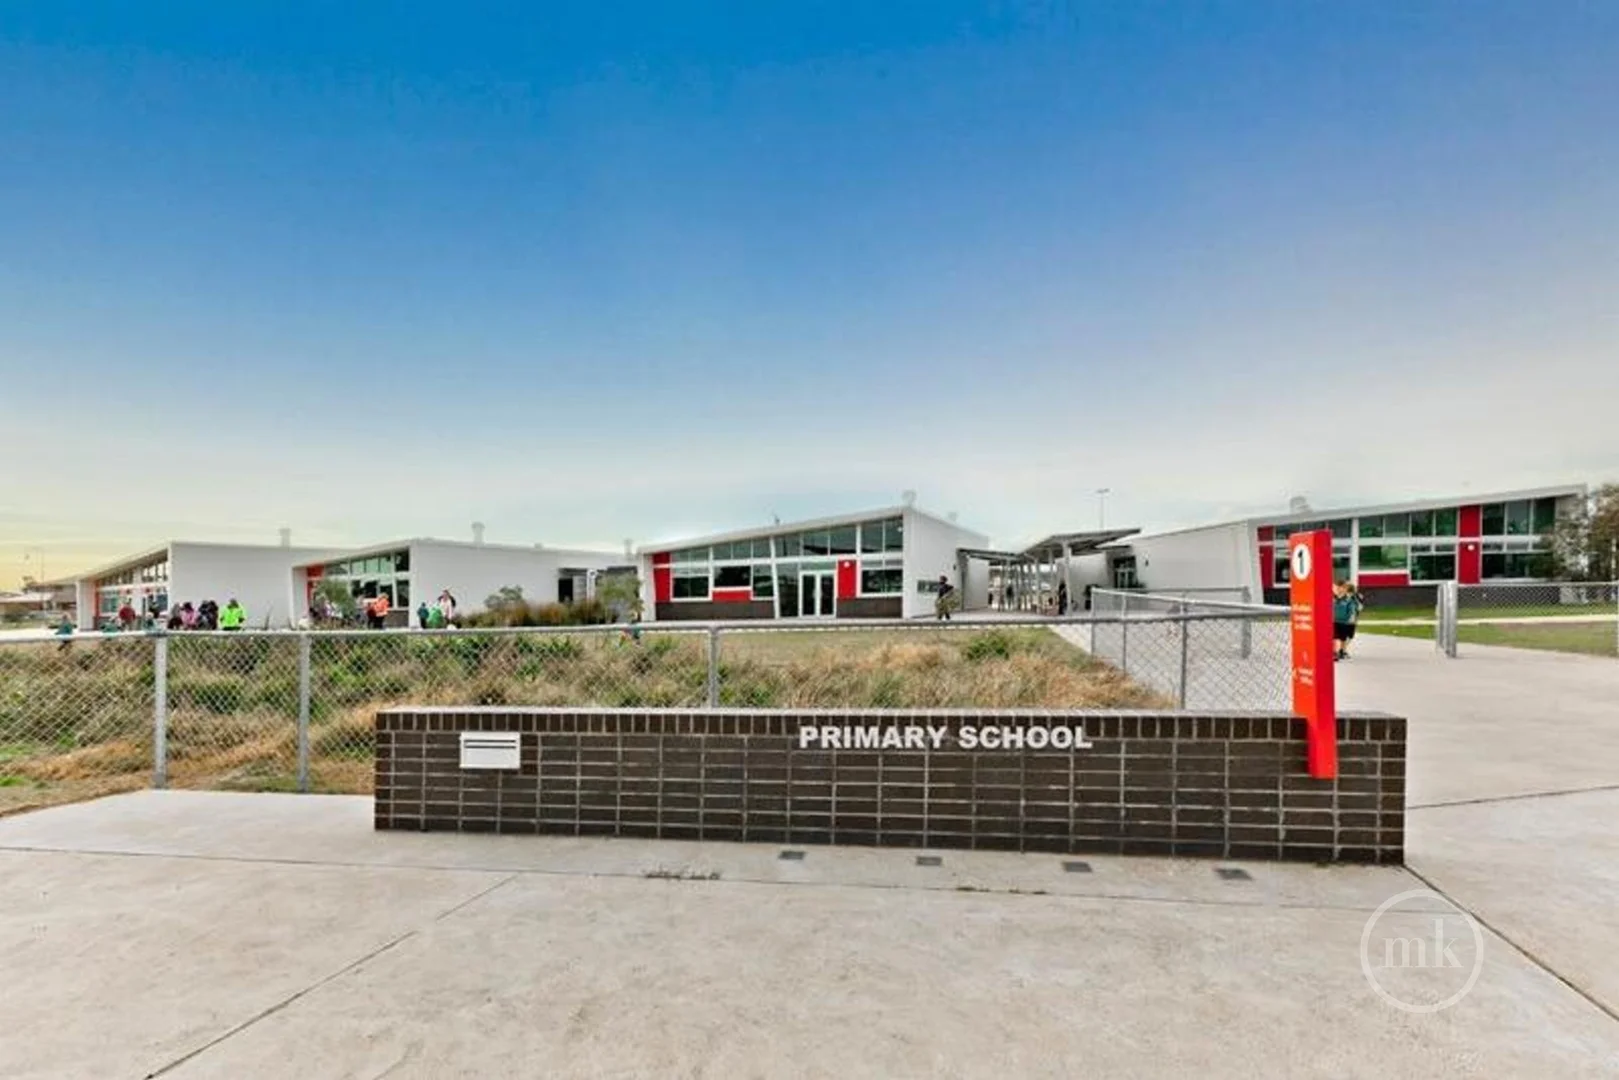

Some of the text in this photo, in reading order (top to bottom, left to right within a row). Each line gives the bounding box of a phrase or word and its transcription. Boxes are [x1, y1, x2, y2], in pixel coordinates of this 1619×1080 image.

[1297, 549, 1305, 575] 1
[800, 725, 1093, 749] PRIMARY SCHOOL
